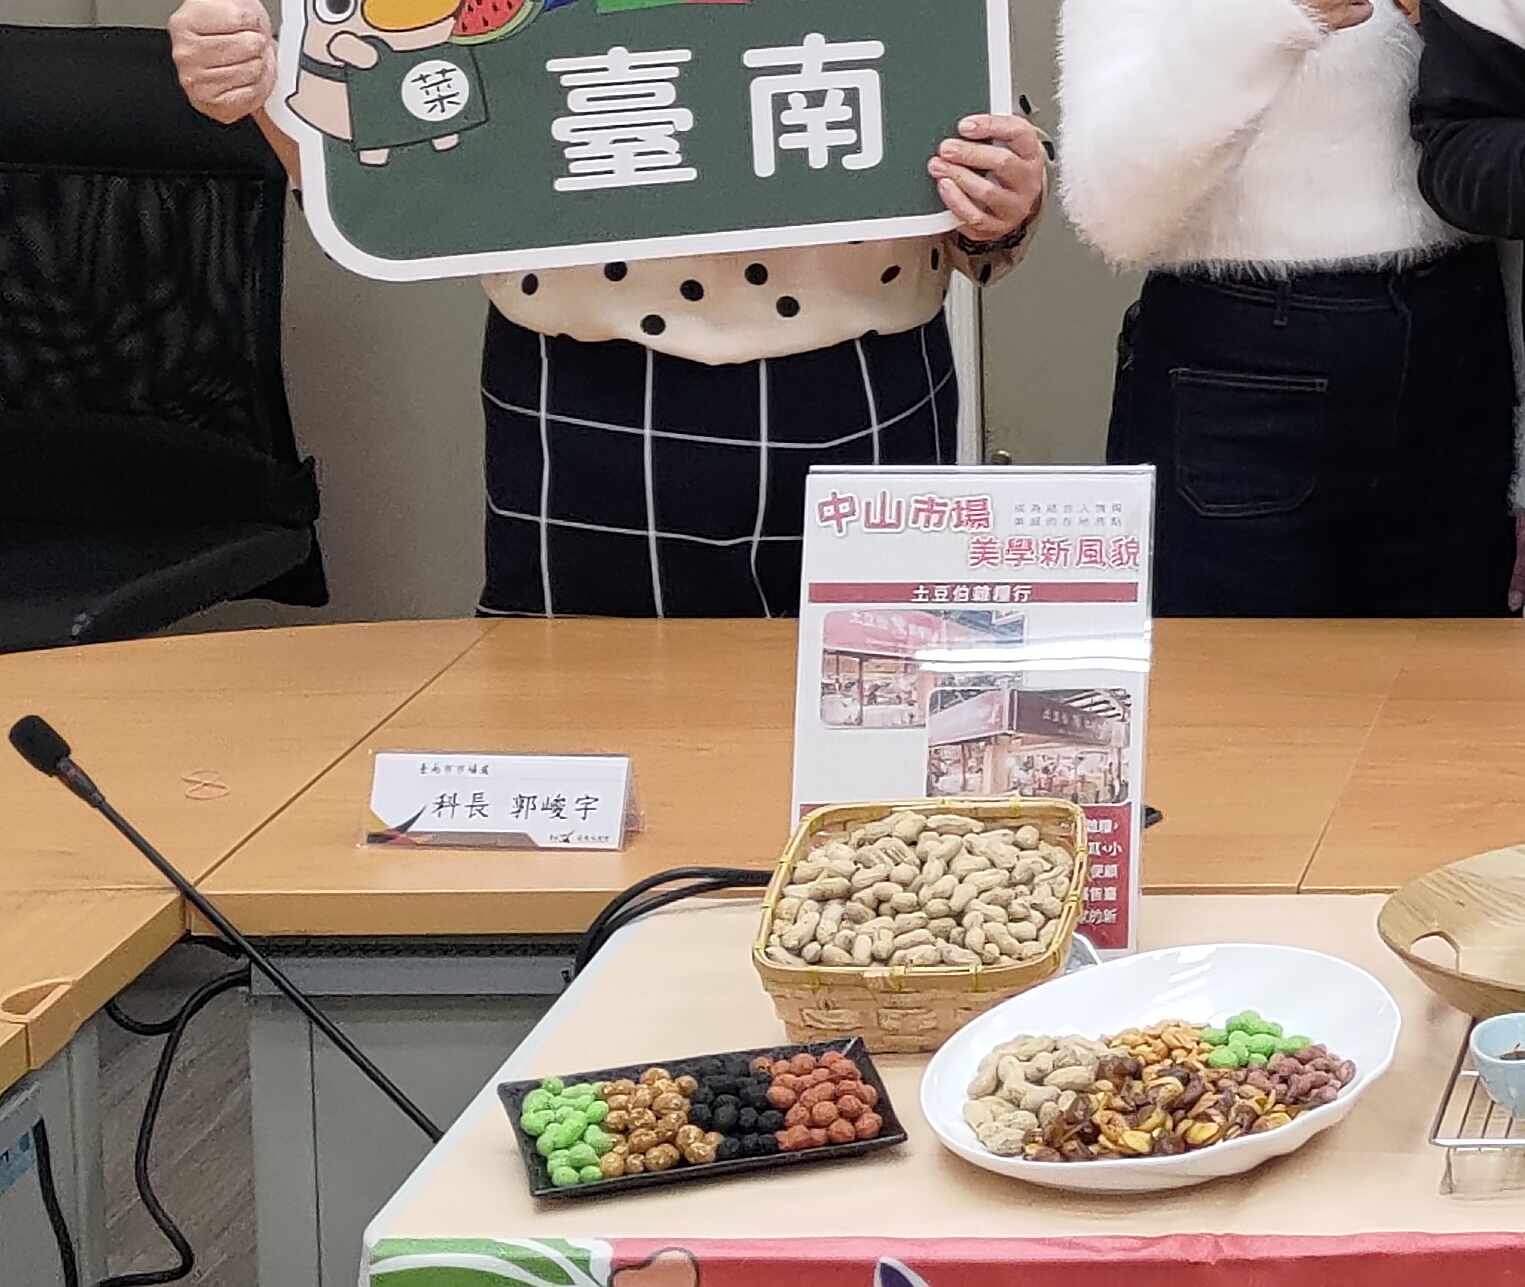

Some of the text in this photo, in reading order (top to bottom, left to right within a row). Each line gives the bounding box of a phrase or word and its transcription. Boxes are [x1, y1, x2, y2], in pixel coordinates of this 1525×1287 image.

[412, 67, 461, 115] 菜
[544, 31, 886, 193] 臺南
[818, 490, 992, 534] 中山市場
[969, 537, 1140, 569] 美學新風貌
[432, 791, 490, 819] 科長
